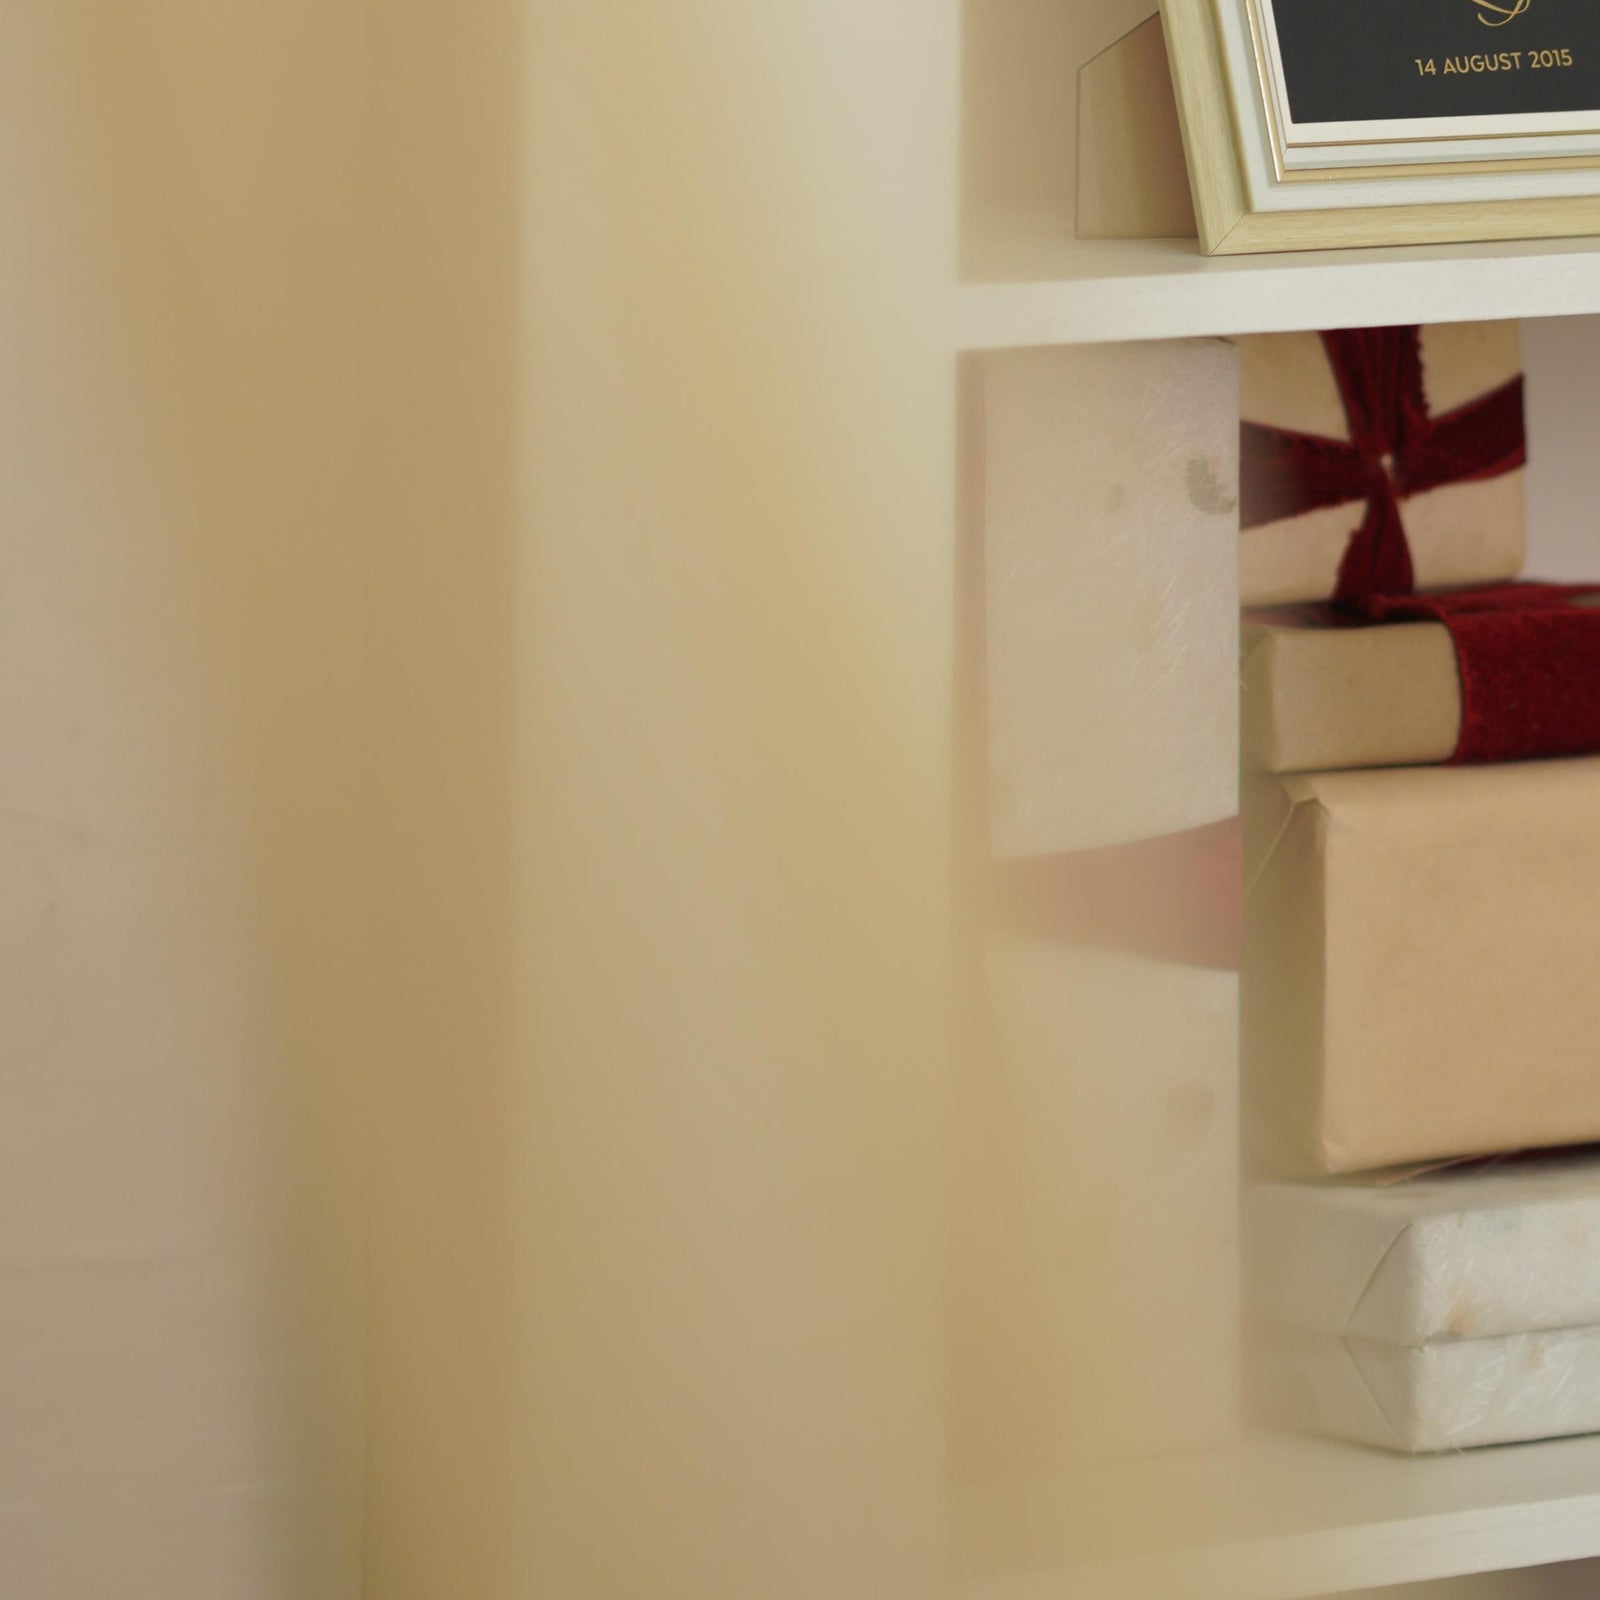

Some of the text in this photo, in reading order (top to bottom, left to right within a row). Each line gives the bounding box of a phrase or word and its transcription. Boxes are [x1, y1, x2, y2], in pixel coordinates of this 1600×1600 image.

[1415, 49, 1573, 76] 14 AUGUST 2015
